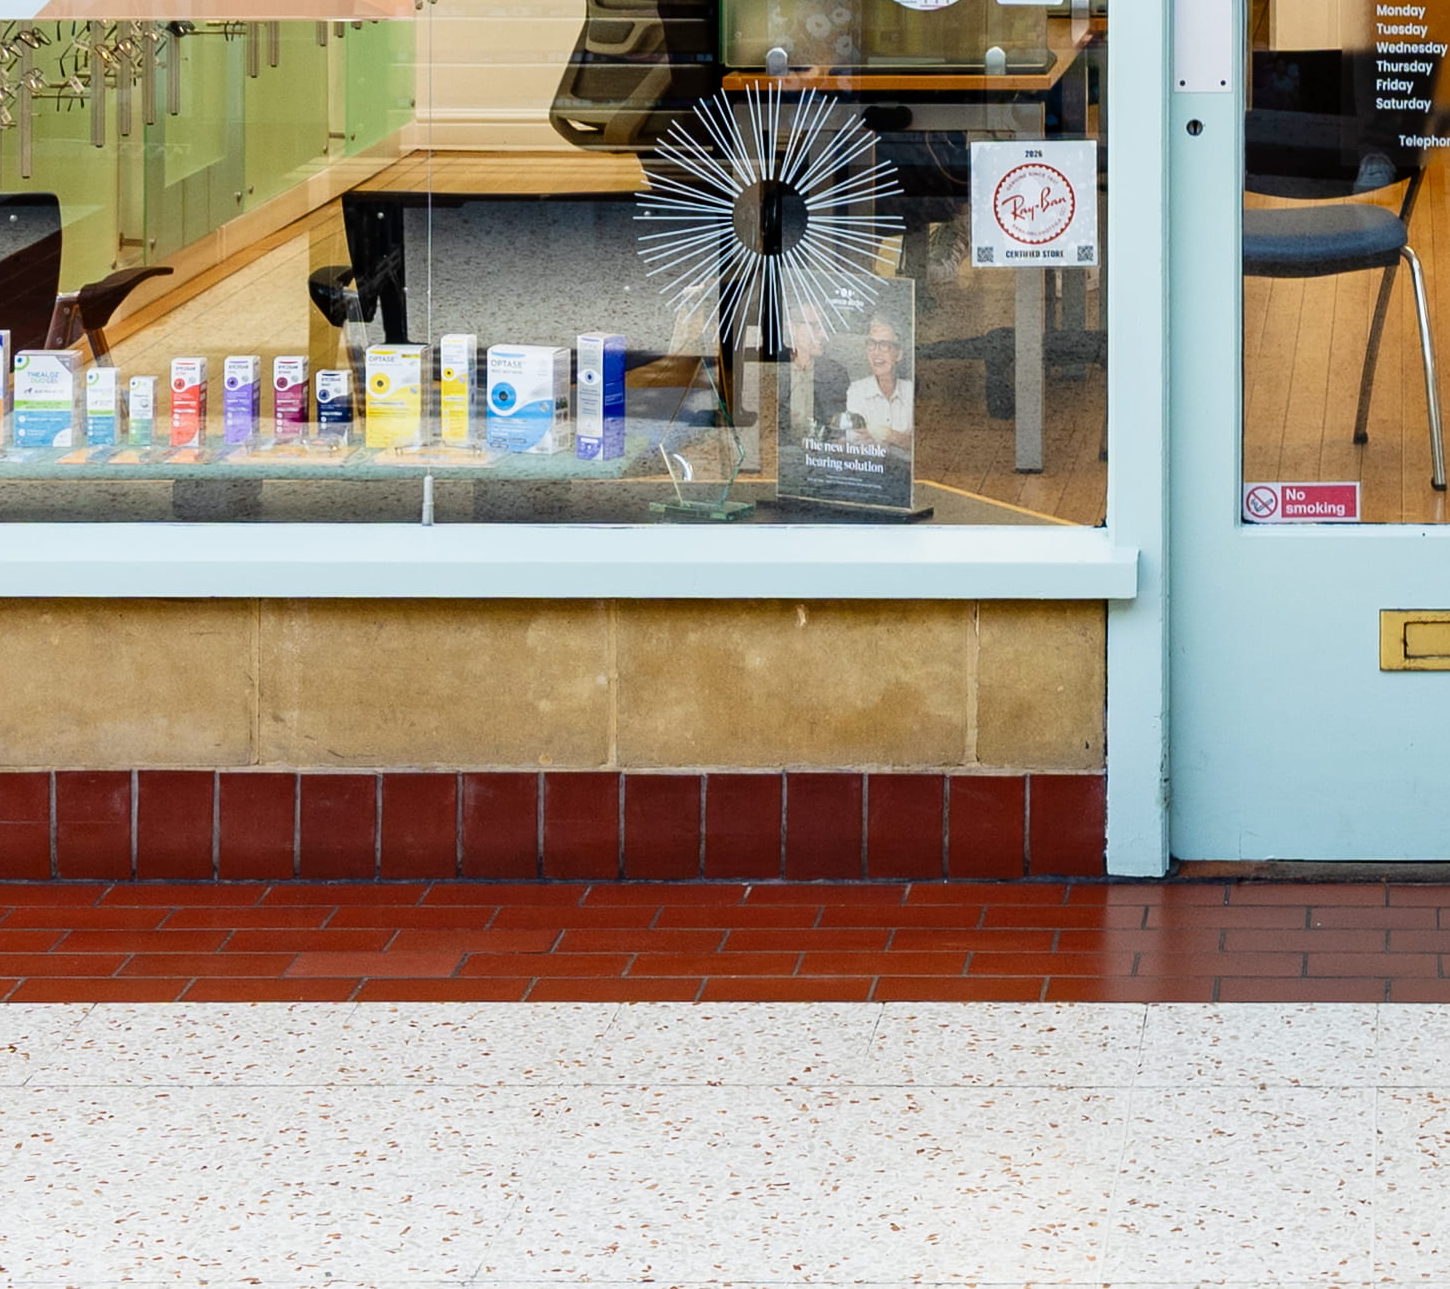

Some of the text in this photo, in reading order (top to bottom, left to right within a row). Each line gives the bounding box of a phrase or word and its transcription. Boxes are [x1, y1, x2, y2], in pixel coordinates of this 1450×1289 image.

[1376, 4, 1426, 20] Monday
[1376, 22, 1428, 38] Tuesday
[1376, 41, 1448, 57] Wednesday
[1376, 60, 1433, 76] Thursday
[1376, 78, 1414, 94] Friday
[1376, 97, 1431, 113] Saturday
[1024, 150, 1044, 158] 2026
[1005, 249, 1064, 258] CERTIFIED STORE
[368, 355, 395, 364] OPTASE
[490, 360, 523, 370] OPTASE
[803, 436, 888, 459] The new invisible
[805, 453, 885, 475] hearing solution
[1285, 488, 1306, 501] No
[1285, 502, 1345, 516] smoking
